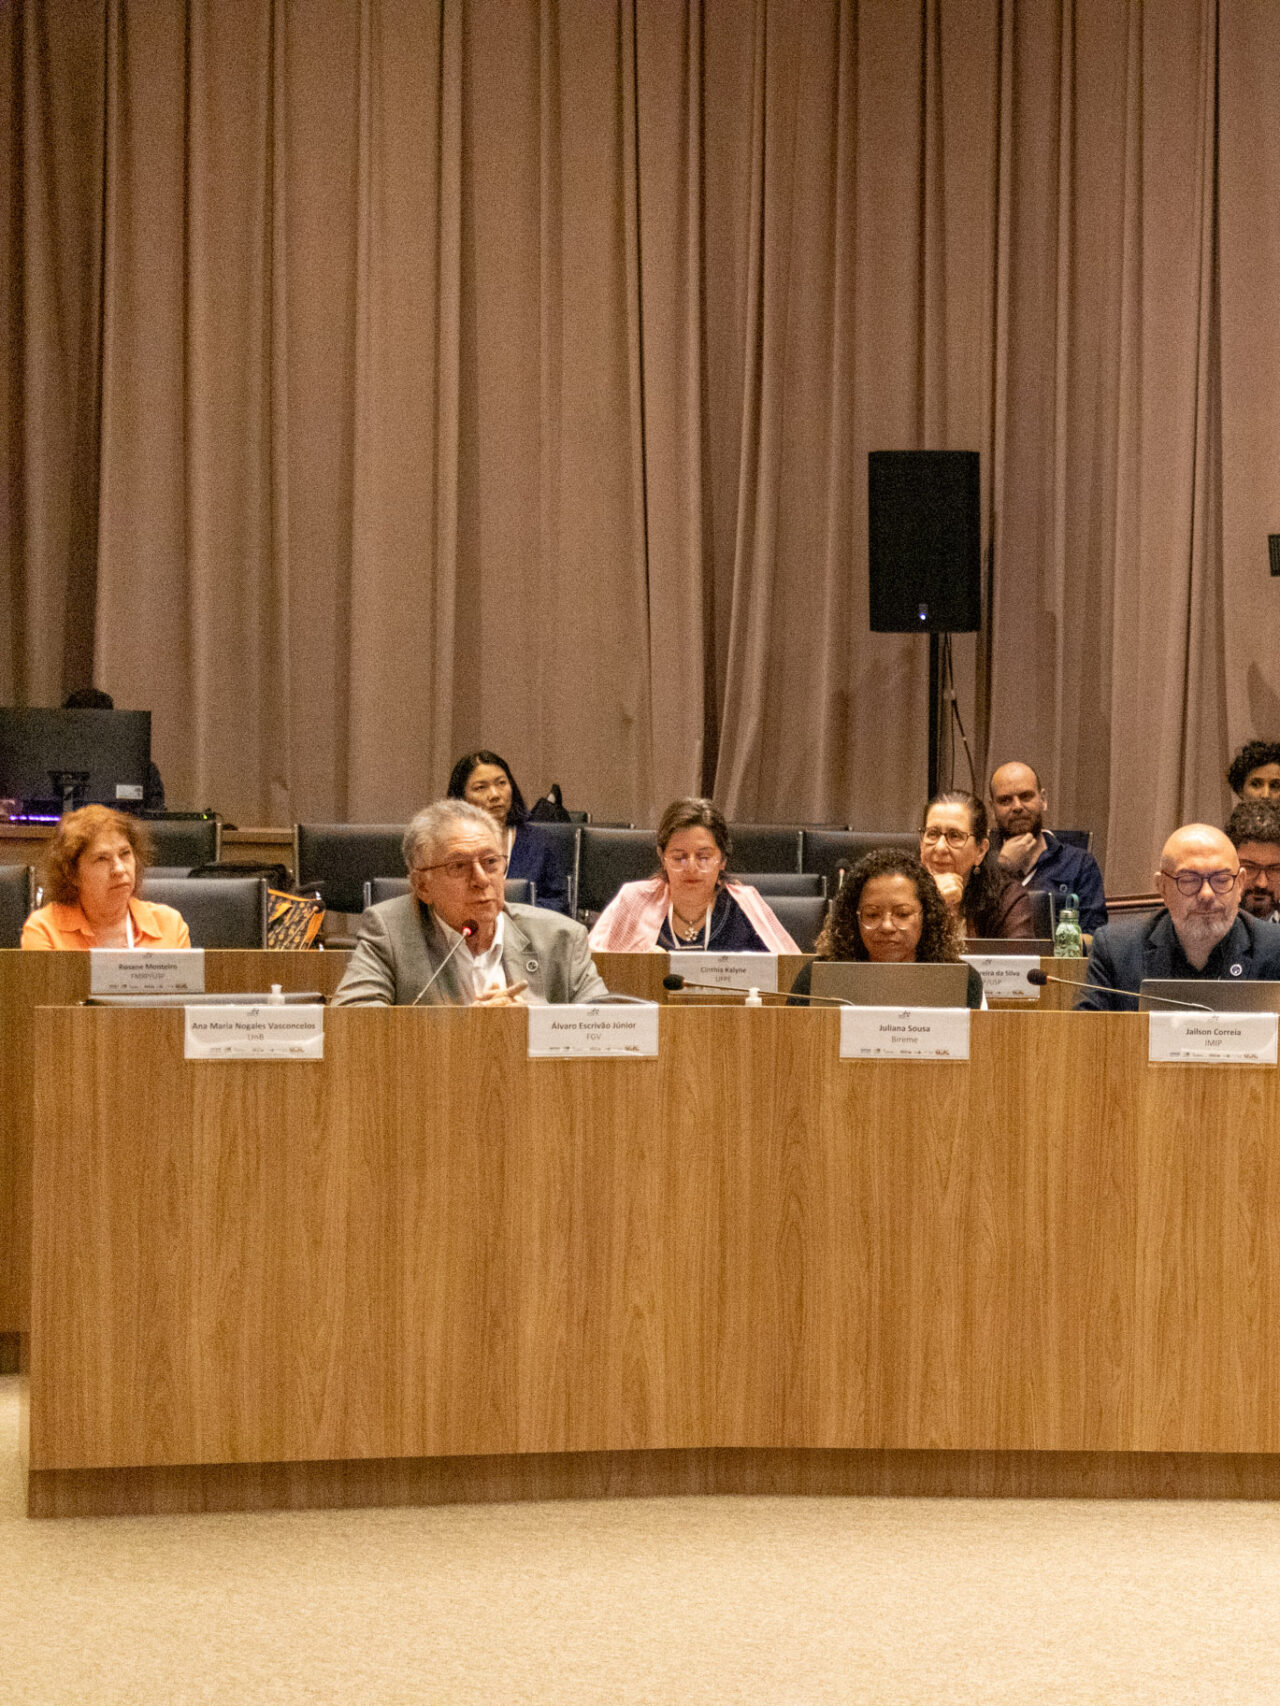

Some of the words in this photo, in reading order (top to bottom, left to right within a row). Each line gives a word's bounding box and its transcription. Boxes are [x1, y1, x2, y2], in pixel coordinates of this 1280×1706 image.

[235, 1022, 266, 1031] Nogales
[552, 1021, 577, 1030] Álvaro
[579, 1022, 610, 1030] Escrivão
[879, 1024, 906, 1032] Juliana
